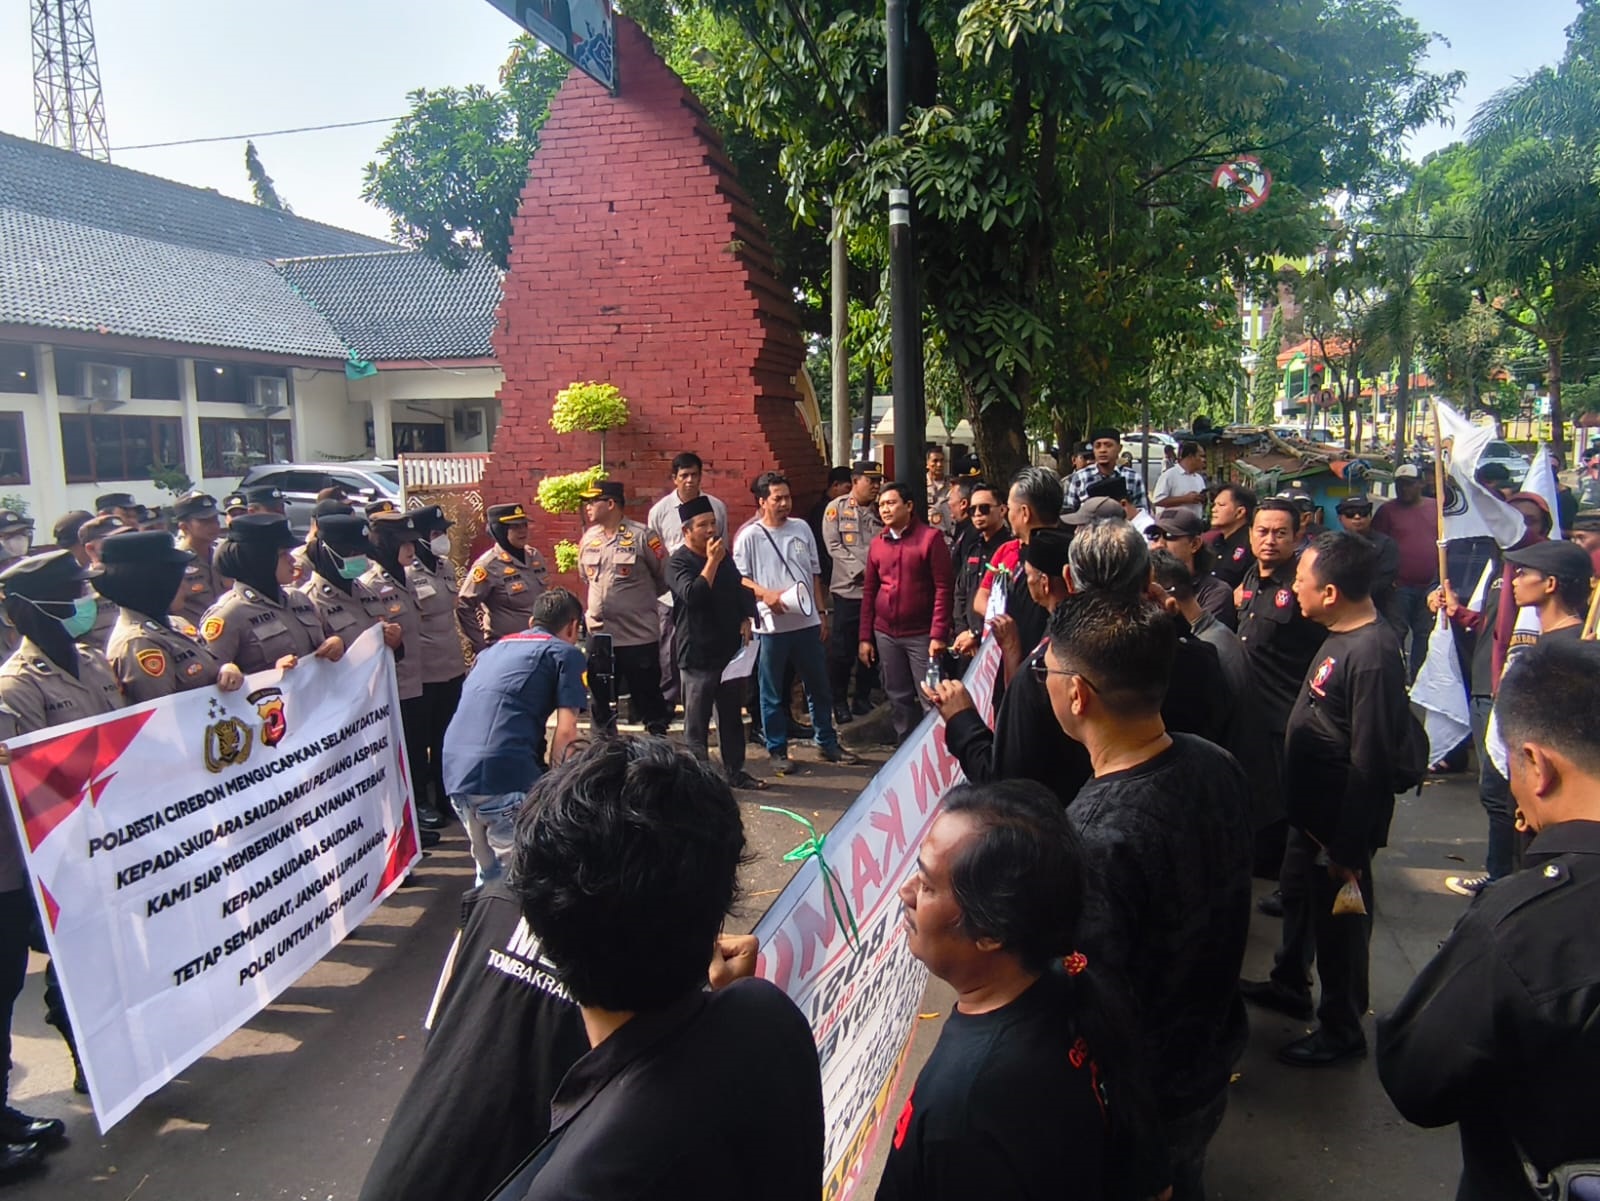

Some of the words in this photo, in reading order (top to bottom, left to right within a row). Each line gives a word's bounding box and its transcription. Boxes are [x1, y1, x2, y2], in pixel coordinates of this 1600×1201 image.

[89, 811, 165, 859] POLRESTA
[164, 784, 227, 823] CIREBON
[225, 740, 323, 796] MENGUCAPKAN
[321, 719, 360, 752] SELAMAT
[116, 845, 185, 890] KEPADA
[179, 815, 243, 858] SAUDARA
[244, 779, 313, 827] SAUDARAKU
[312, 755, 353, 791] PEJUANG
[146, 881, 191, 918] KAMI
[193, 864, 222, 894] SIAP
[222, 821, 296, 876] MEMBERIKAN
[295, 786, 356, 832] PELAYANAN
[355, 766, 387, 796] TERBAIK
[173, 944, 222, 986] TETAP
[223, 898, 295, 957] SEMANGAT,
[294, 868, 337, 909] JANGAN
[336, 851, 357, 880] LUPA
[222, 875, 273, 919] KEPADA
[272, 844, 321, 886] SAUDARA
[239, 946, 276, 986] POLRI
[277, 917, 316, 958] UNTUK
[314, 872, 369, 930] MASYARAKAT
